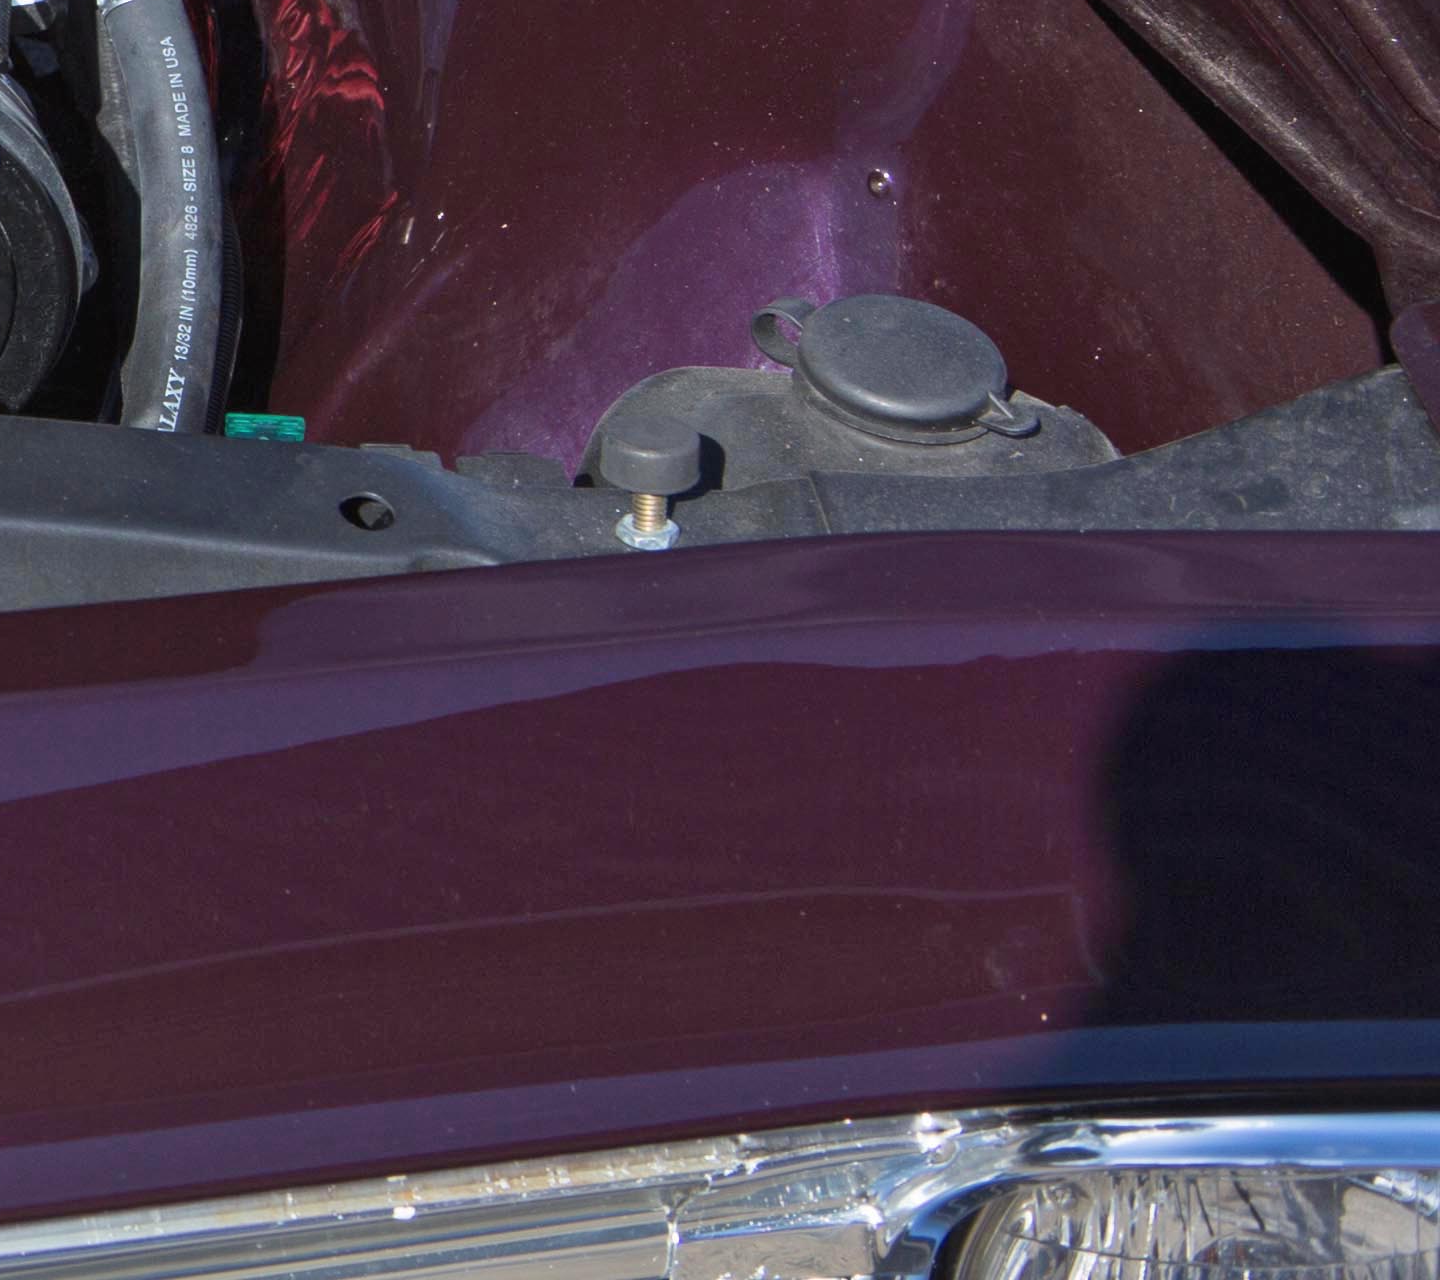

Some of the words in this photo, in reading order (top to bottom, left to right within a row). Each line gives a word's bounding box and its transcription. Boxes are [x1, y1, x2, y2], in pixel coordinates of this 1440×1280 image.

[160, 35, 179, 69] USA
[168, 72, 184, 89] IN
[172, 91, 193, 137] MADE
[180, 145, 195, 154] 8
[181, 158, 197, 192] SIZE
[184, 205, 199, 240] 4826
[182, 249, 199, 302] (10mm)
[178, 305, 194, 322] IN
[174, 323, 192, 361] 13/32
[157, 367, 186, 433] LAXY
